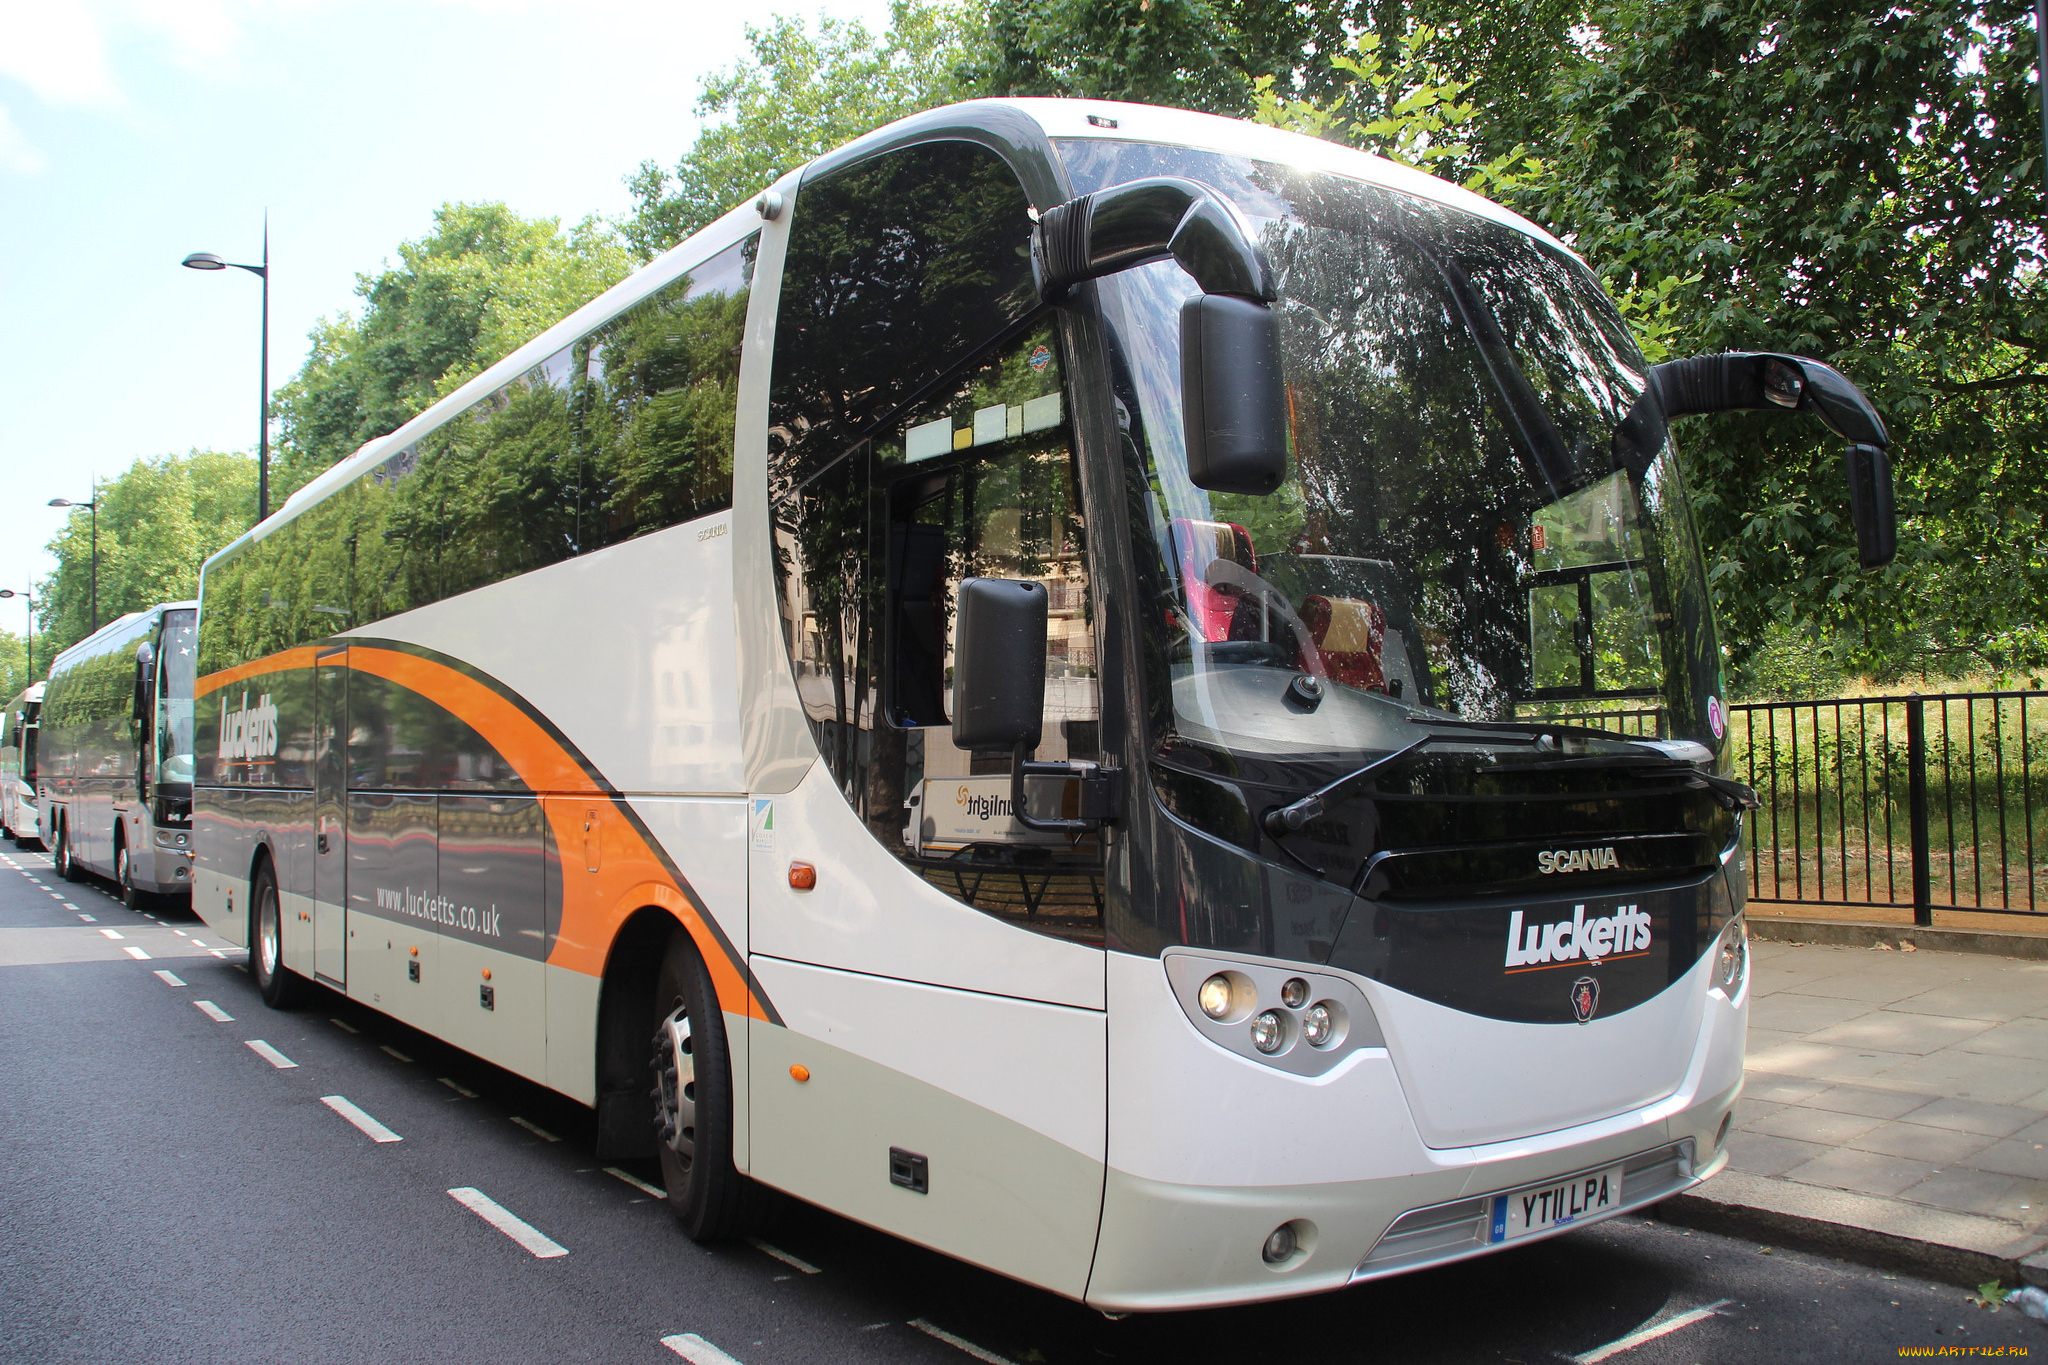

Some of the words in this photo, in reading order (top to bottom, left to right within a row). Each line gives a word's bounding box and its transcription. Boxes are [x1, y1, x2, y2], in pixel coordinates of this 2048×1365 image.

[218, 691, 278, 760] Lucketts
[1538, 847, 1620, 874] SCANIA
[377, 886, 500, 937] www.lucketts.co.uk
[1504, 904, 1652, 967] Lucketts
[1494, 1223, 1504, 1234] GB
